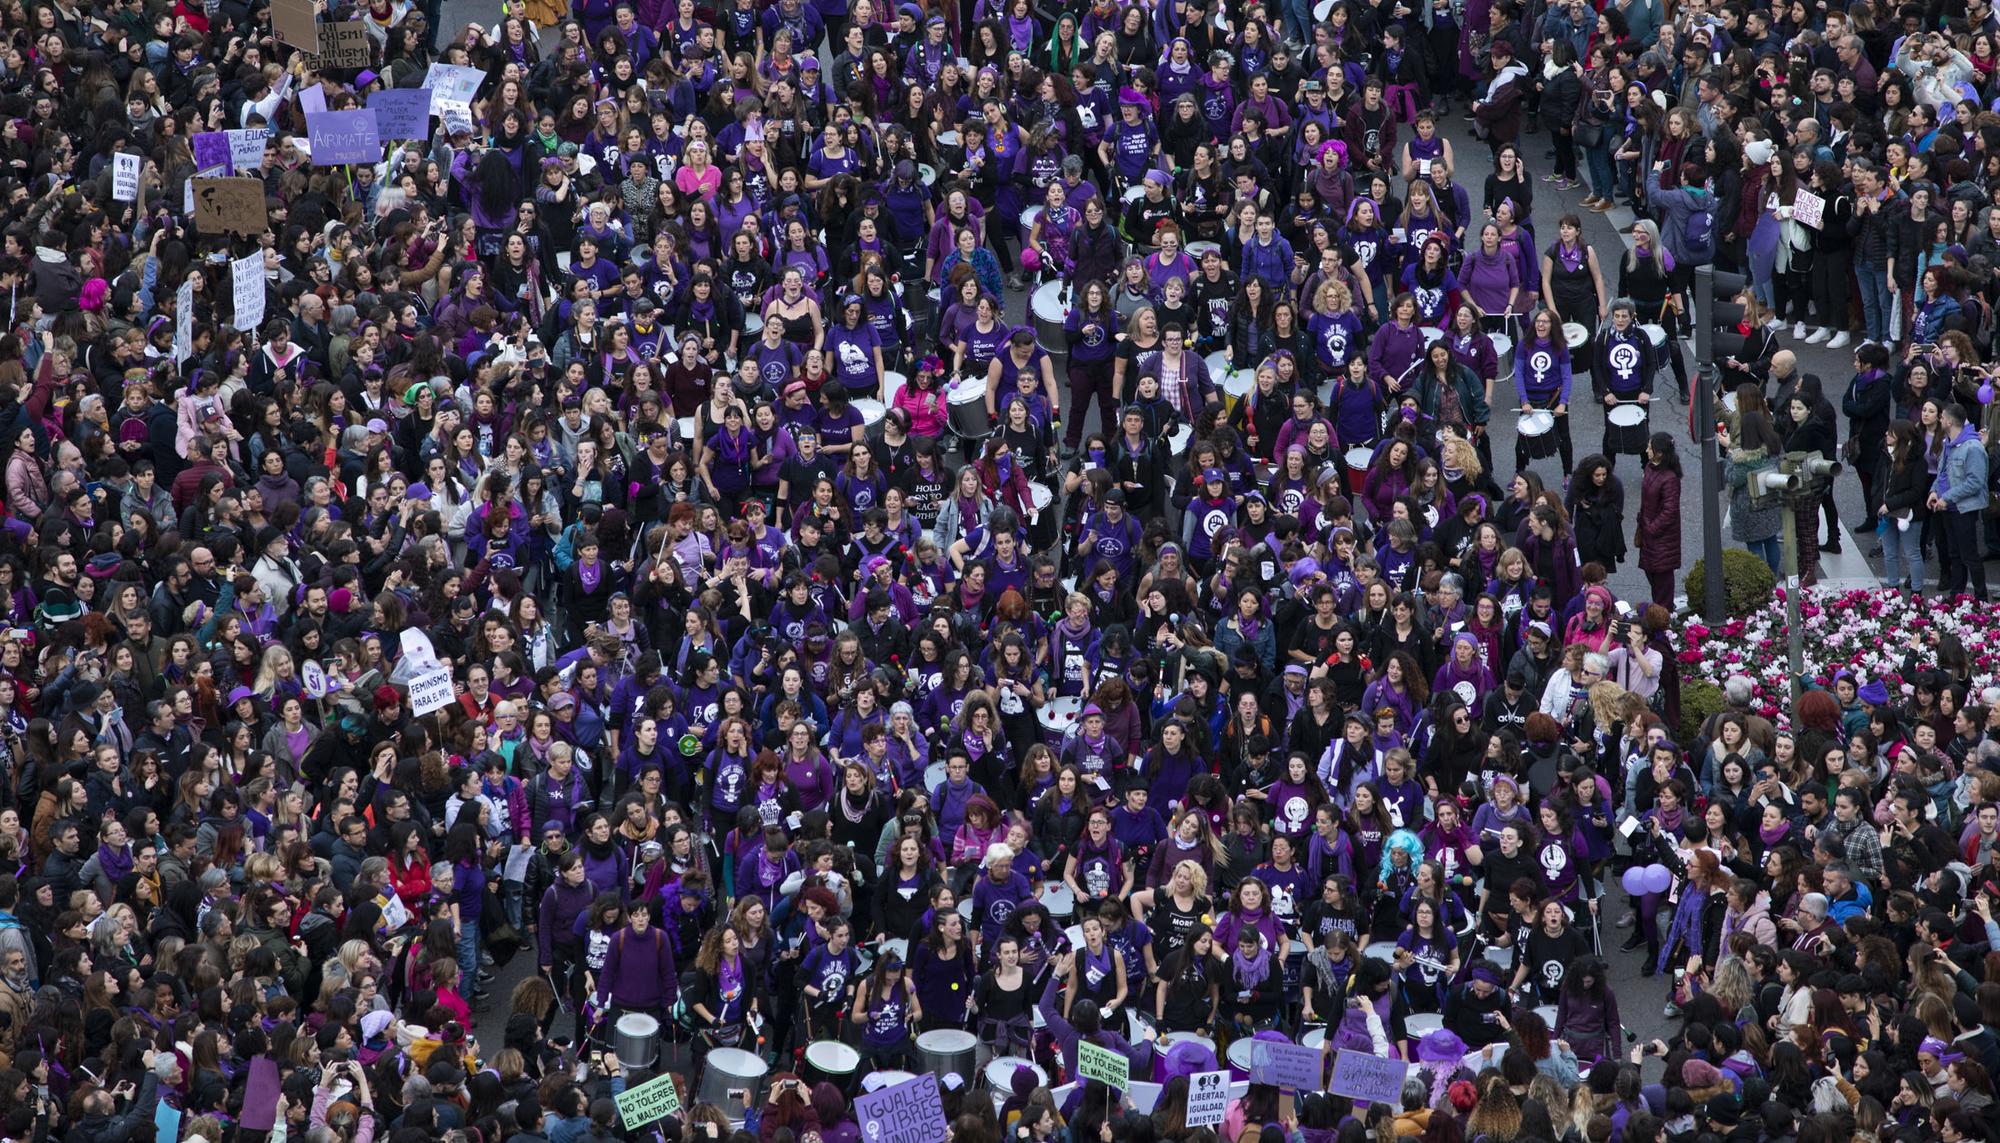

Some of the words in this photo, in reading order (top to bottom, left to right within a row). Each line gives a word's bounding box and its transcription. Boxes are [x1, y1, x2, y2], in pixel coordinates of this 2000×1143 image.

[915, 484, 941, 493] HOLD
[916, 502, 936, 511] EAC
[309, 673, 321, 691] SÍ
[411, 673, 448, 694] FEMINISMO
[414, 695, 432, 708] PARA
[1080, 1052, 1092, 1064] NO
[1093, 1057, 1128, 1079] TOLERES
[1080, 1064, 1089, 1075] EL
[621, 1103, 635, 1116] NO
[636, 1086, 675, 1109] TOLERES
[863, 1076, 936, 1120] IGUALES
[1190, 1091, 1226, 1102] LIBERTAD,
[625, 1116, 637, 1127] EL
[637, 1098, 677, 1122] MALTRATO
[881, 1095, 943, 1136] LIBRES
[1189, 1102, 1225, 1114] IGUALDAD,
[1188, 1113, 1223, 1125] AMISTAD.
